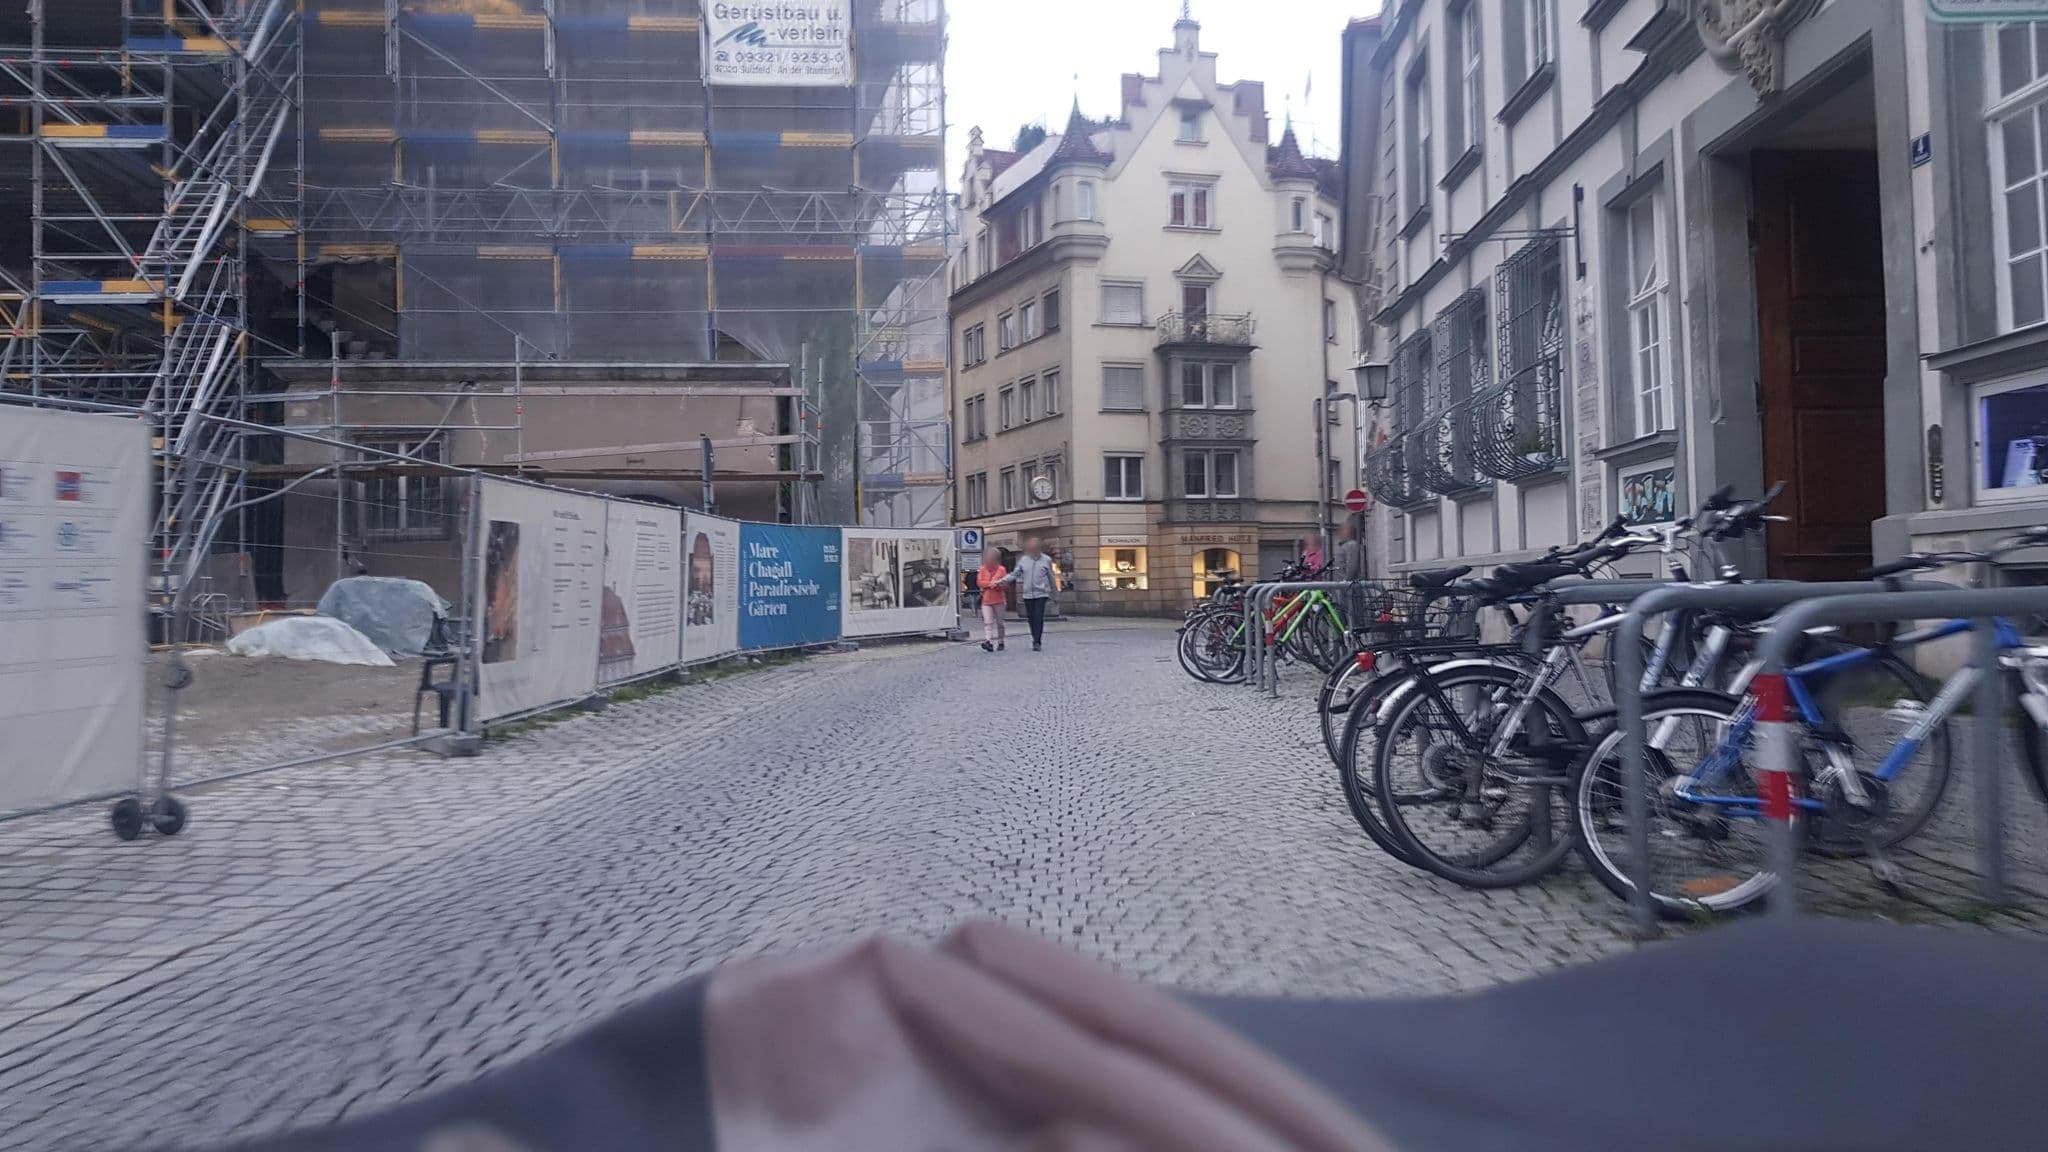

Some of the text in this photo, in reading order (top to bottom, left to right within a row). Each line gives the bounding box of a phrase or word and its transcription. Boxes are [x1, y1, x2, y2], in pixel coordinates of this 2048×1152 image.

[714, 3, 842, 20] Gerüstbau u.
[749, 542, 779, 558] Marc
[749, 560, 793, 579] Chagall
[749, 579, 820, 597] Paradiesische
[748, 600, 787, 616] Gärten
